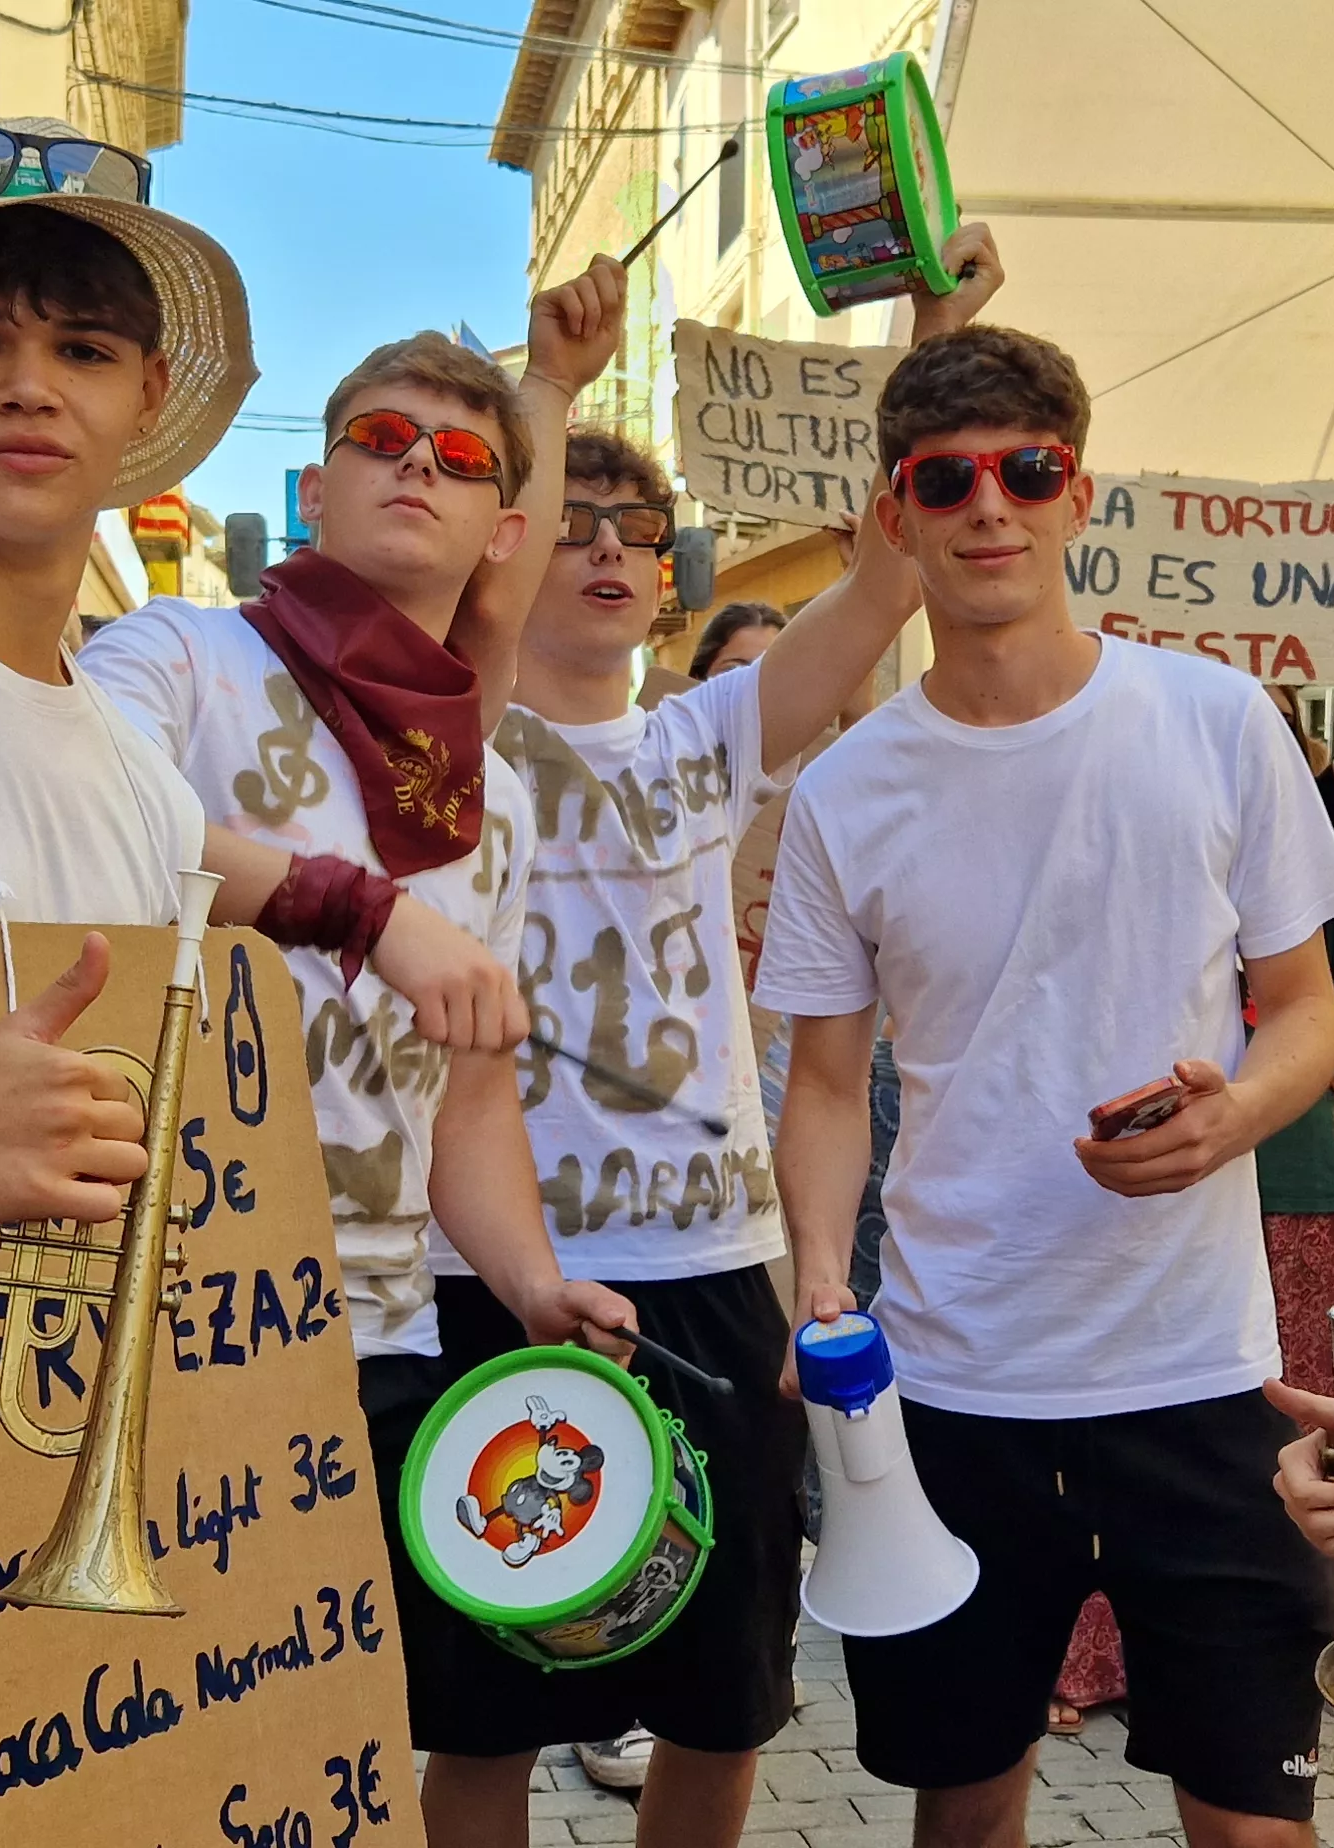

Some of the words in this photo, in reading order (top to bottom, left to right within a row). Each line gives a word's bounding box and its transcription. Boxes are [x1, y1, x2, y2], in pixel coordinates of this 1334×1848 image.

[706, 340, 774, 400] NO
[800, 356, 862, 399] ES
[1090, 487, 1136, 529] A
[1147, 554, 1217, 605] ES
[394, 784, 416, 815] DE
[82, 1658, 184, 1754] Cola
[195, 1604, 316, 1712] Normal
